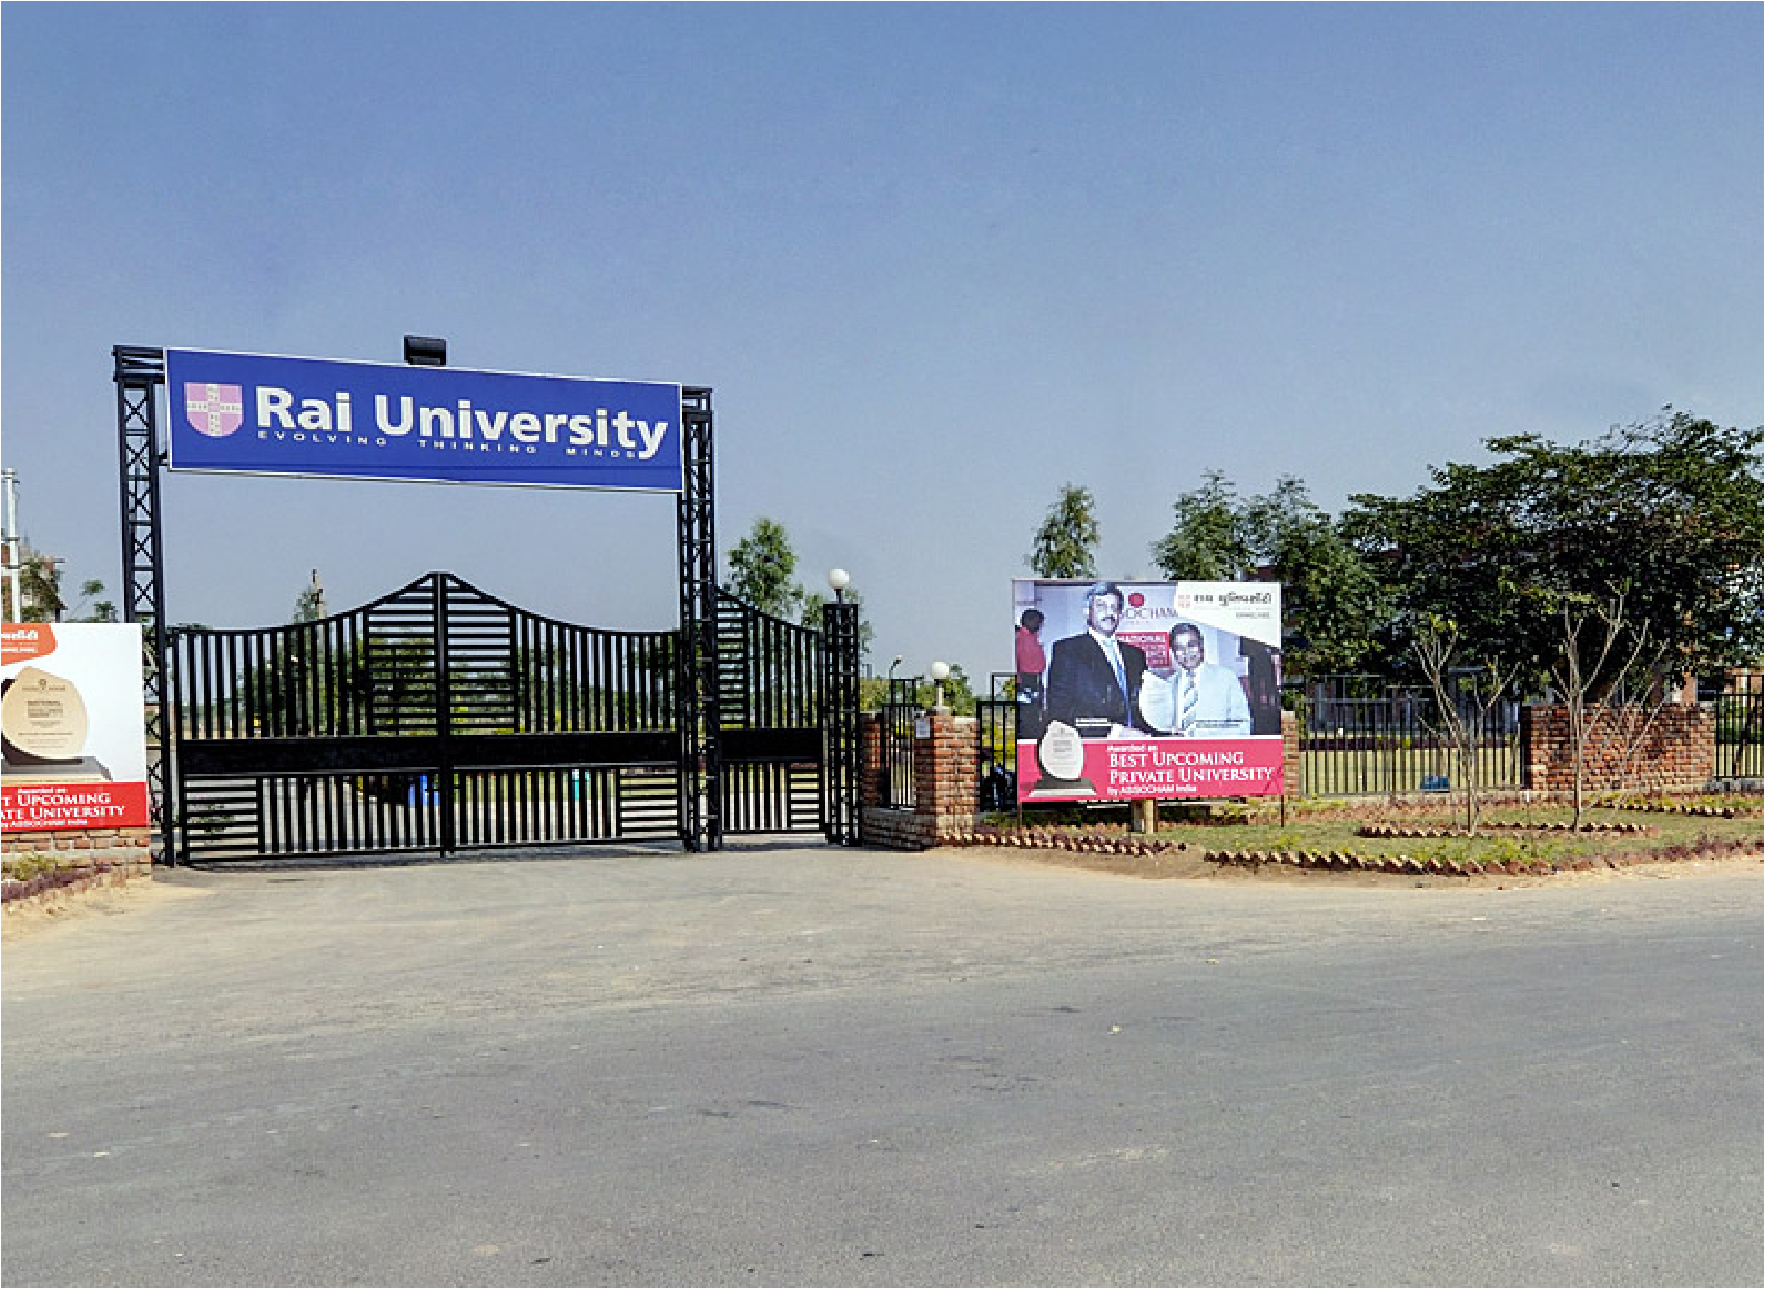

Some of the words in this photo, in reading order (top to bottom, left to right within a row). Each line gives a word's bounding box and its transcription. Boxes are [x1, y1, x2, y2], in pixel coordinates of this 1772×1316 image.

[256, 385, 352, 432] Rai
[374, 393, 669, 460] University
[257, 430, 388, 448] EVOLVING
[417, 439, 537, 454] THINKING
[564, 448, 637, 460] MINDS
[1110, 752, 1149, 768] BEST
[1152, 751, 1245, 766] UPCOMING
[1110, 769, 1175, 785] PRIVATE
[1180, 766, 1274, 782] UNIVERSITY
[17, 792, 111, 807] UPCOMING
[30, 805, 125, 819] UNIVERSITY
